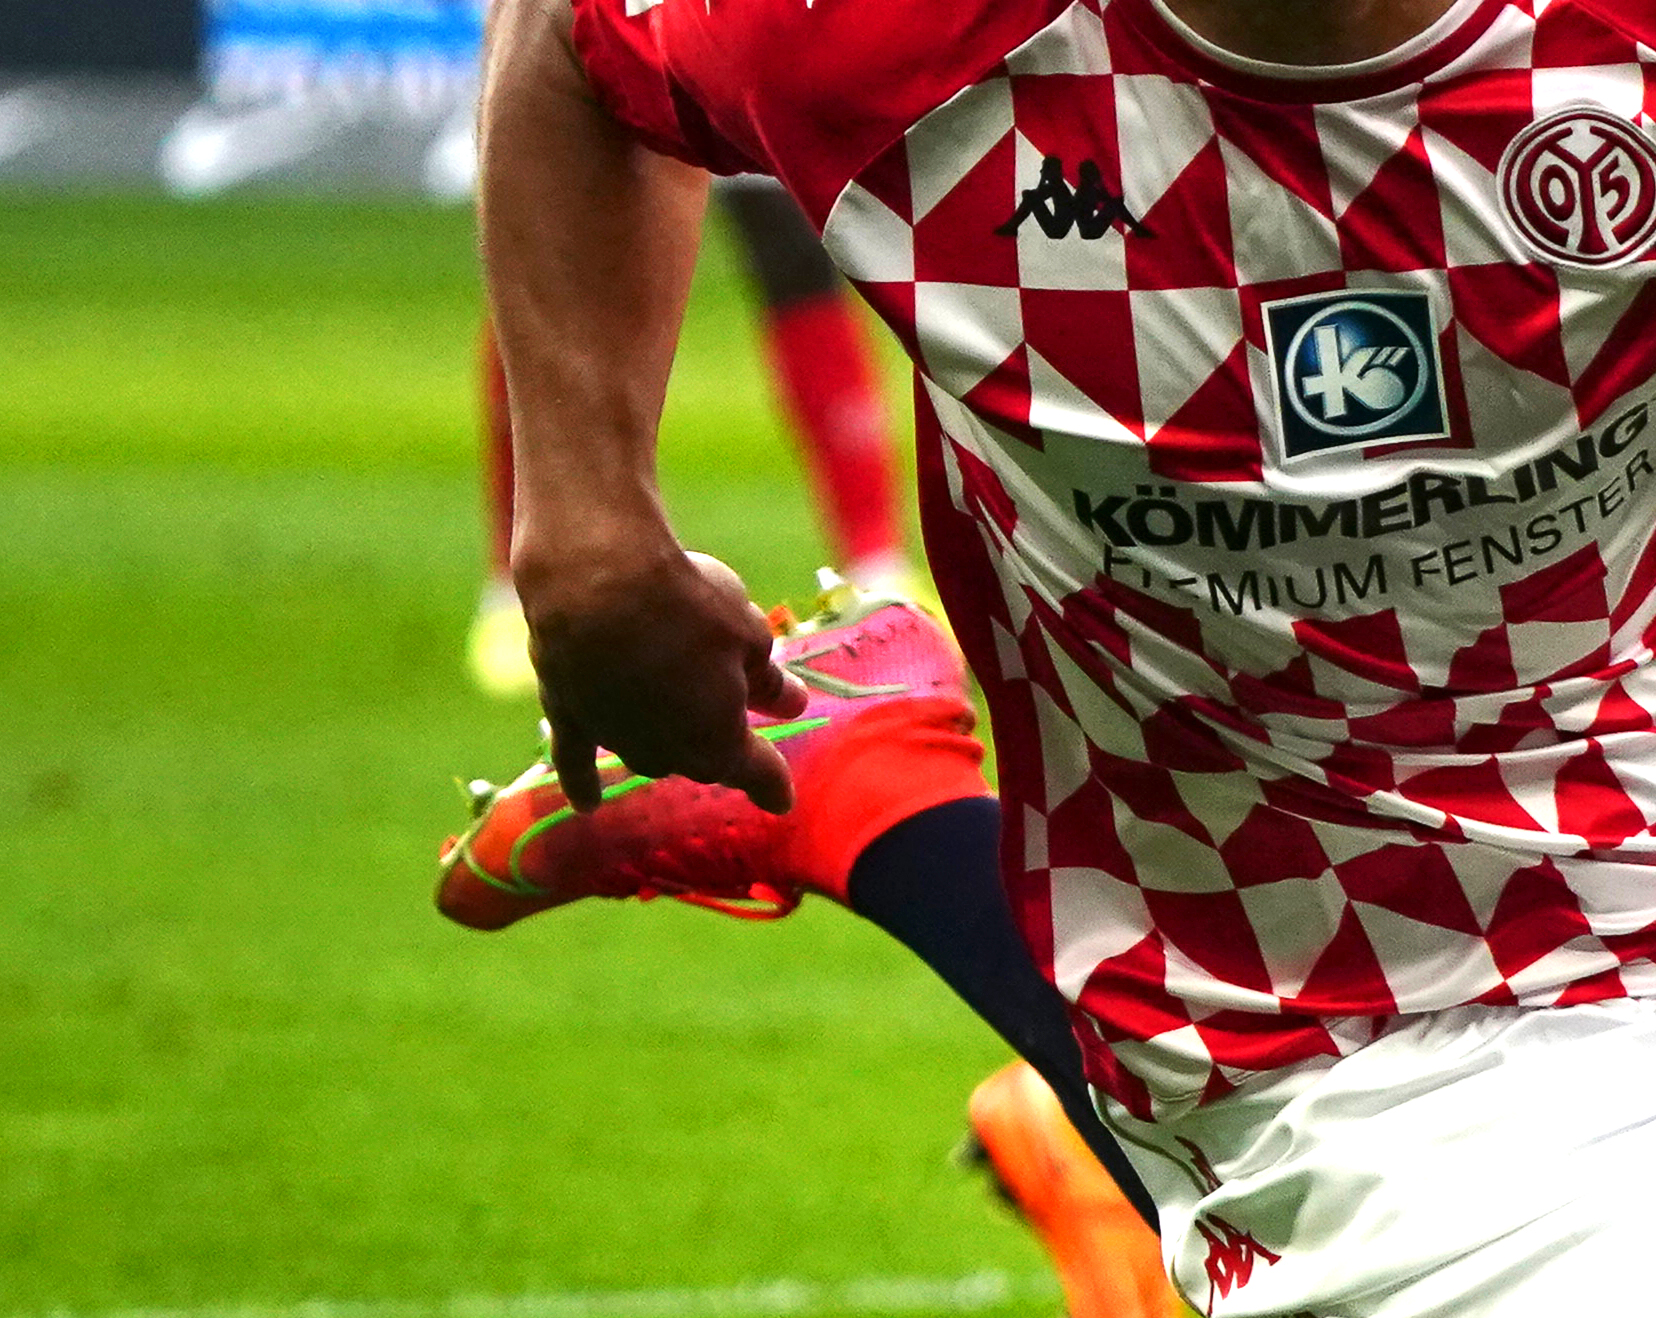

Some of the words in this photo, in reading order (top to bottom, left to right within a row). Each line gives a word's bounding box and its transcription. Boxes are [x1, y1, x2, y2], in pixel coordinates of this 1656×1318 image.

[1072, 401, 1651, 551] KÖMMERLING
[1103, 543, 1388, 616] MIUM
[1410, 447, 1655, 588] FENSTER
